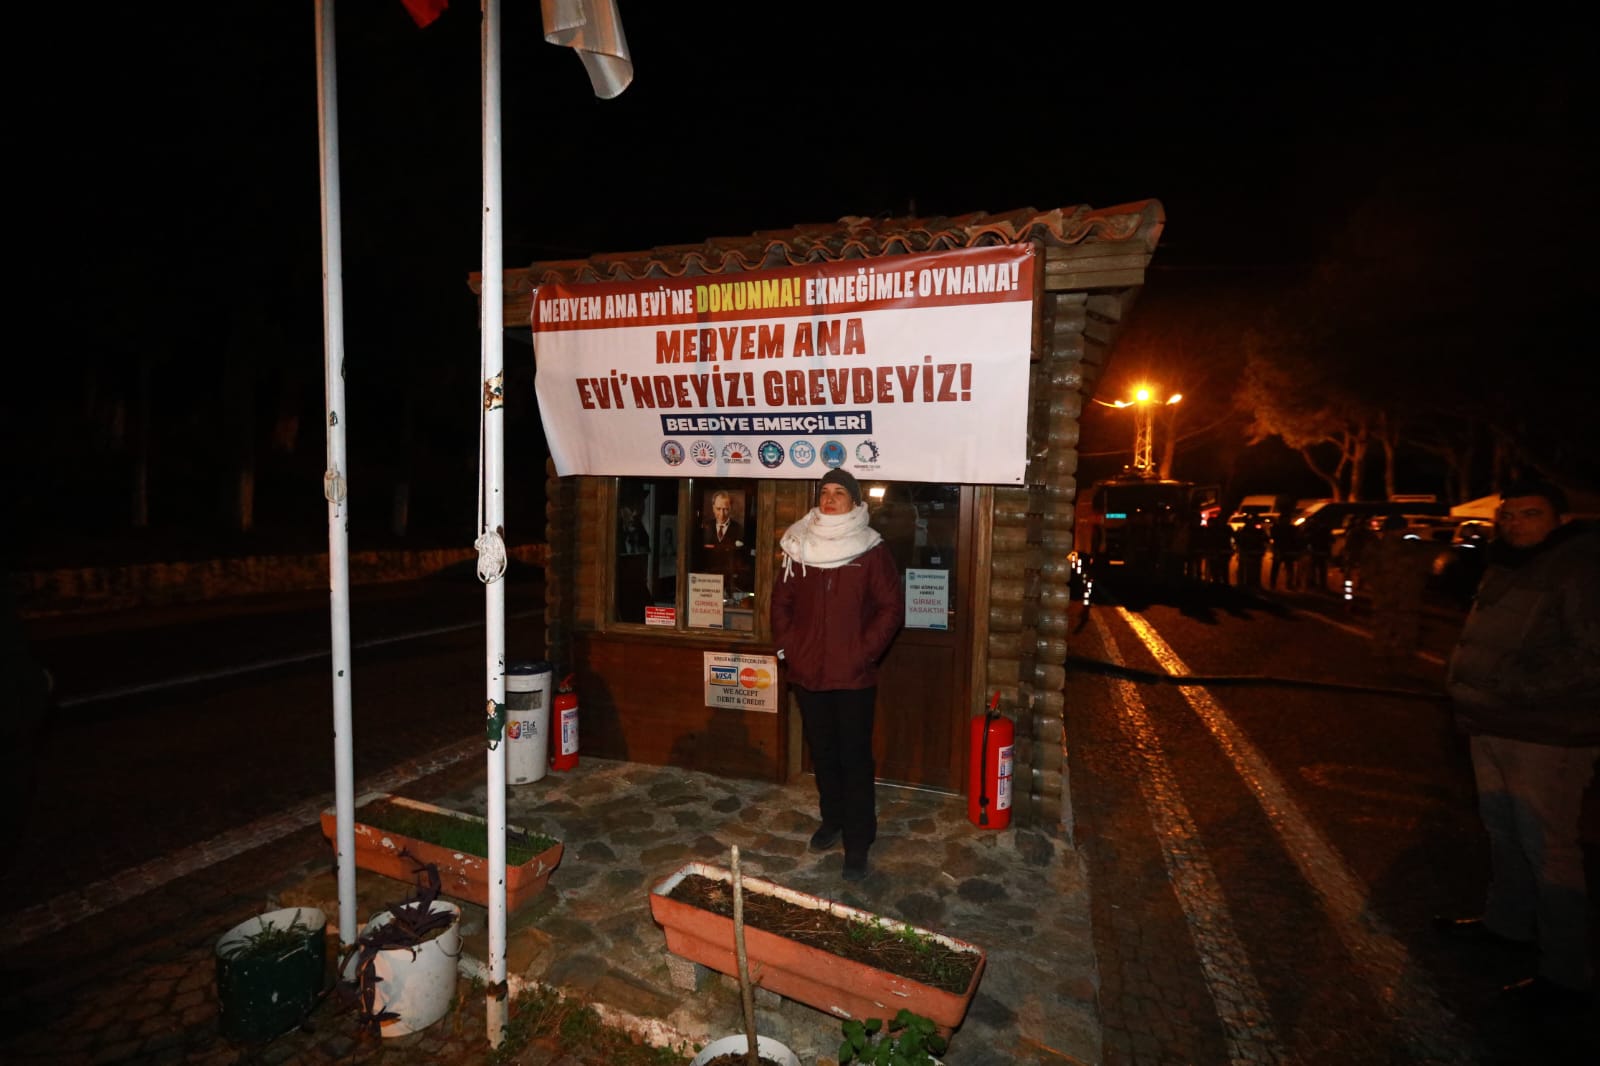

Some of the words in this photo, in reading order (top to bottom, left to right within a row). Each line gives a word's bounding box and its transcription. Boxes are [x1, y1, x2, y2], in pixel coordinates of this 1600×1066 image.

[539, 296, 601, 323] MERYEM
[604, 293, 638, 319] ANA
[696, 278, 800, 312] DOKUNMA!
[806, 268, 914, 305] EKMEĞİMLE
[919, 263, 1020, 296] OYNAMA!
[656, 323, 785, 364] MERYEM
[793, 318, 866, 358] ANA
[576, 365, 756, 410] EVİ'NDEYİZ!
[763, 355, 973, 407] GREVDEYİZ!
[667, 416, 750, 431] BELEDİYE
[715, 672, 732, 680] VISA
[723, 687, 734, 695] WE
[734, 688, 760, 697] ACCEPT
[716, 695, 735, 704] DEBIT
[742, 697, 766, 706] CREDIT
